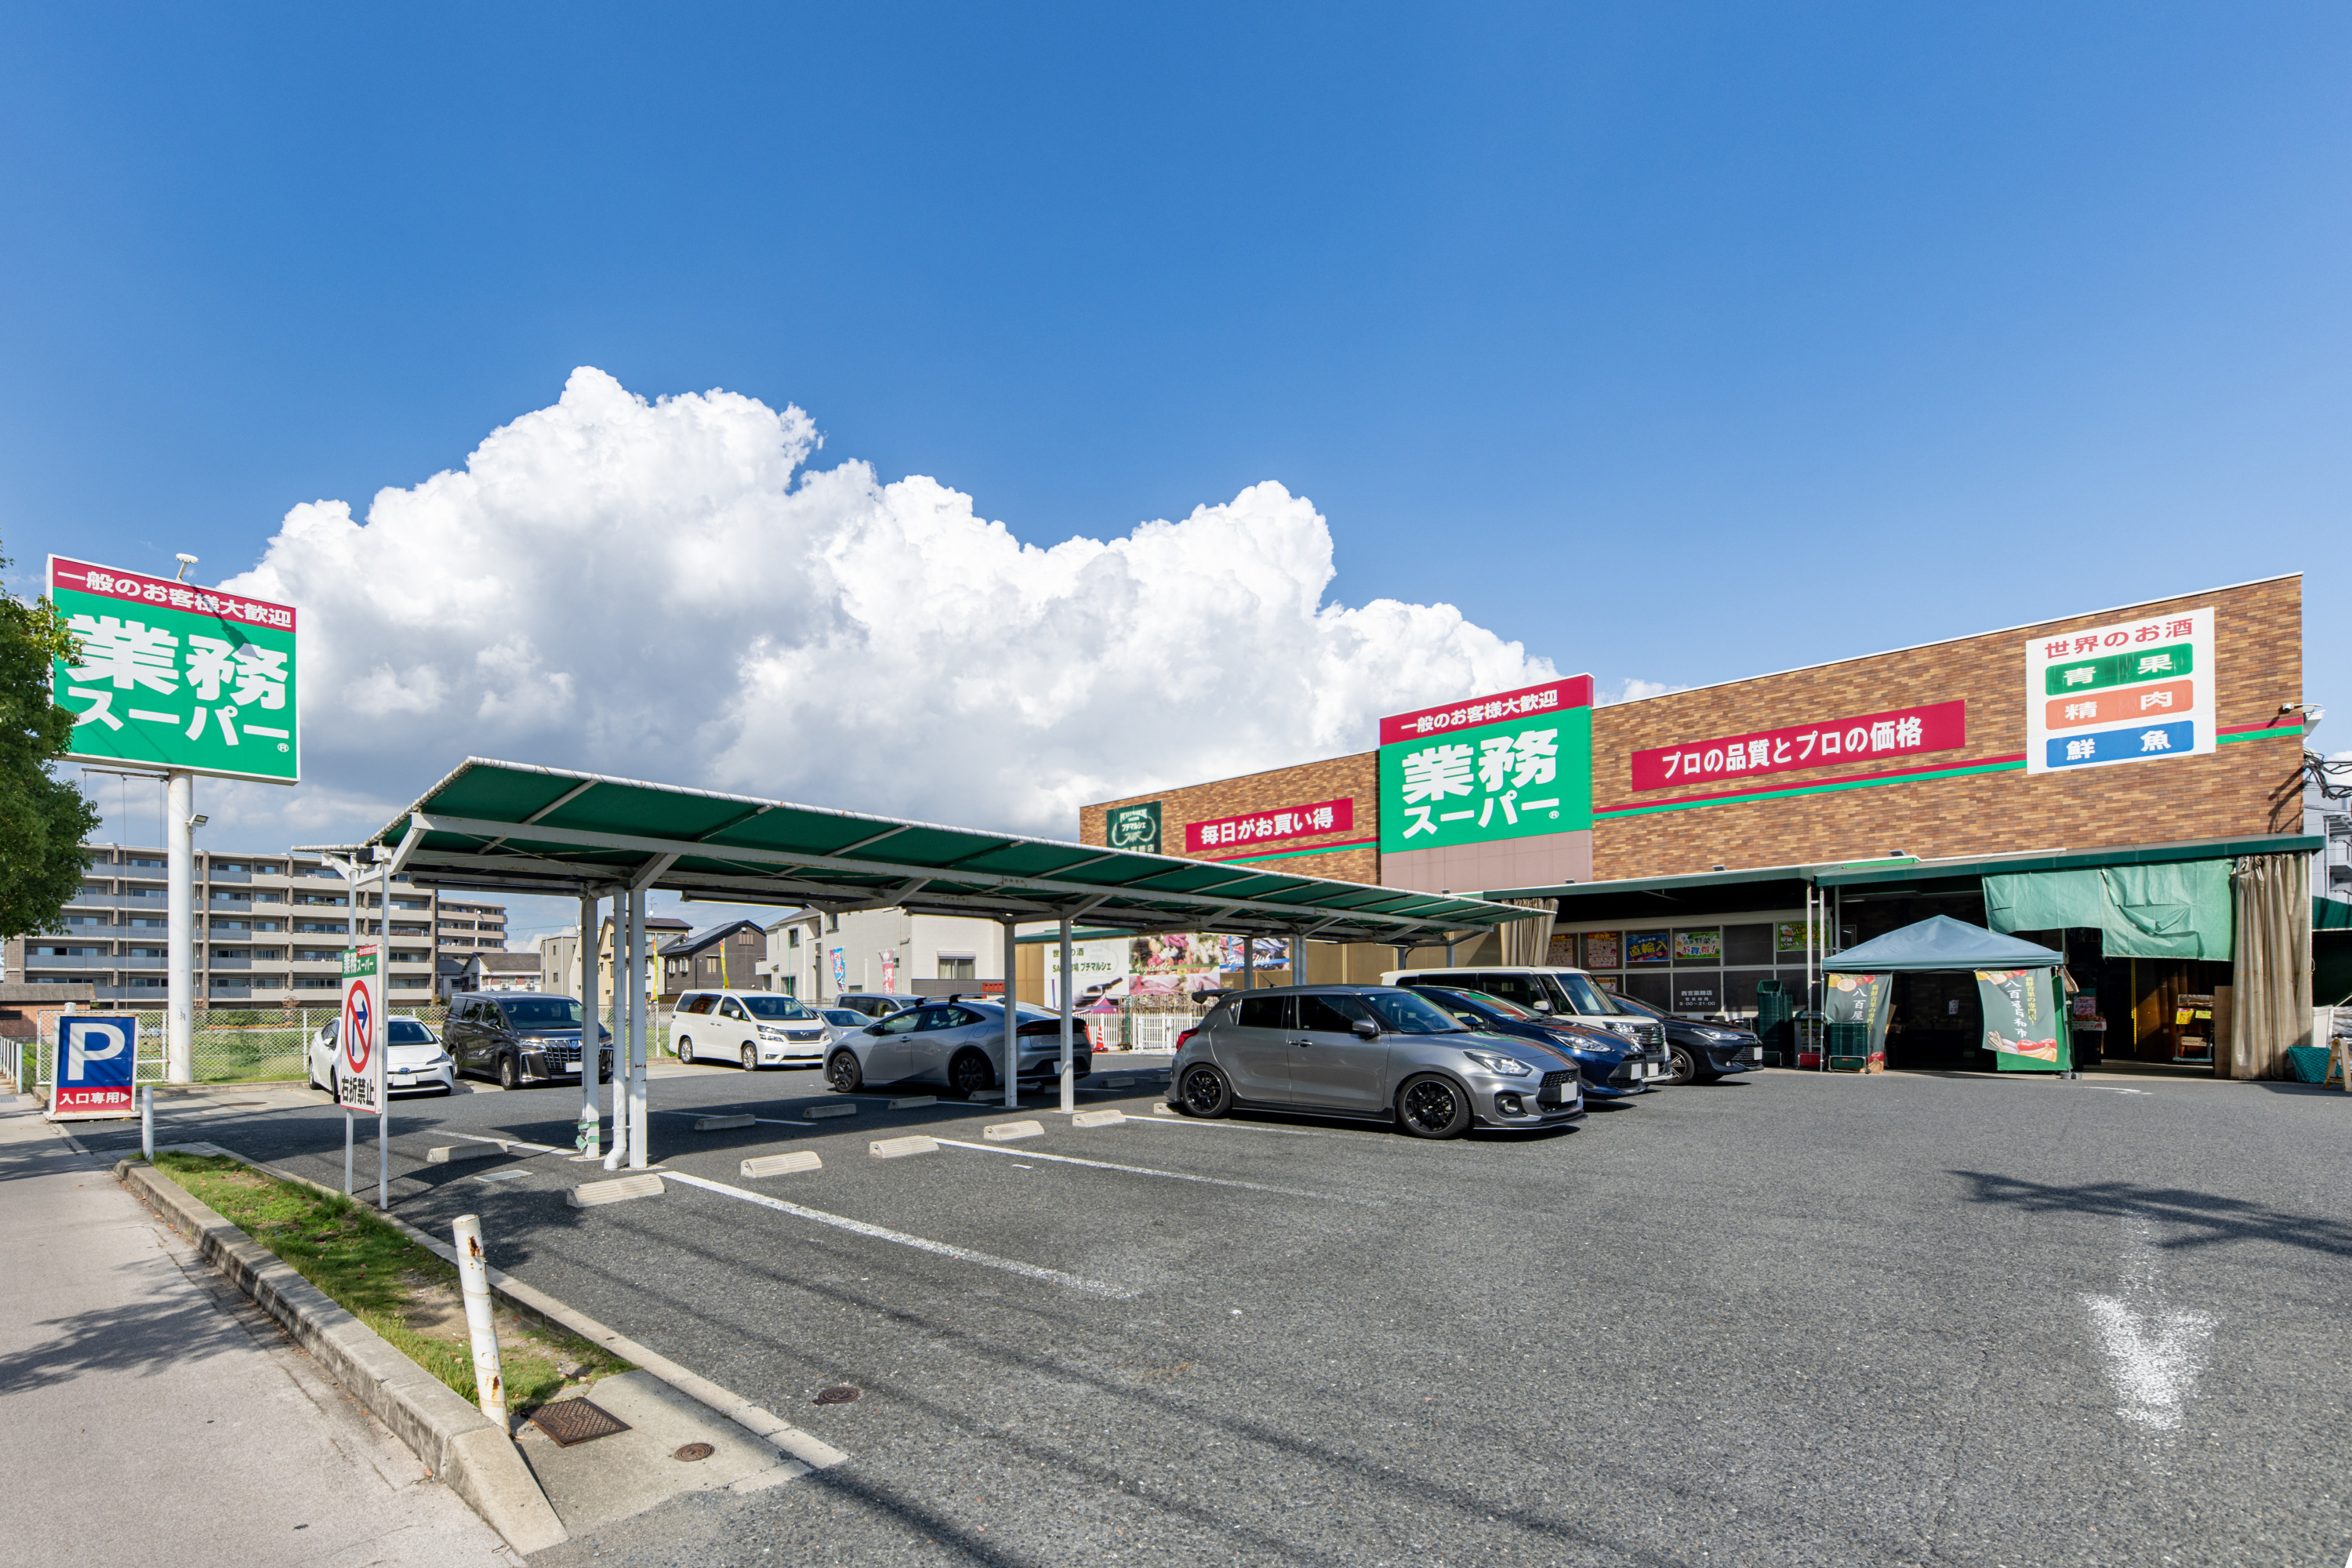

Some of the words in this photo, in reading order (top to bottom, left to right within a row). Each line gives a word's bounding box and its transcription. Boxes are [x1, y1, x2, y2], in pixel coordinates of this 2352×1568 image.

[57, 571, 292, 627] 一般のお客様大歓迎
[2045, 619, 2194, 659] 世界のお酒
[65, 614, 289, 710] 業務
[68, 686, 289, 746] スーパー
[1401, 689, 1558, 733] 一般のお客様大歓迎
[1402, 728, 1559, 805] 業務
[1662, 717, 1922, 779] プロの品質とプロの価格
[1201, 807, 1334, 844] 毎日がお買い得
[1403, 789, 1559, 839] スーパー
[1053, 947, 1083, 957] 世の酒
[1080, 962, 1112, 972] プチマルシェ
[1135, 964, 1171, 972] Vegetable
[1629, 941, 1668, 956] 直輸入
[1850, 988, 1867, 1023] 八百屋
[67, 1022, 125, 1080] P
[59, 1091, 120, 1105] 入口専用
[341, 1075, 375, 1106] 右折禁止
